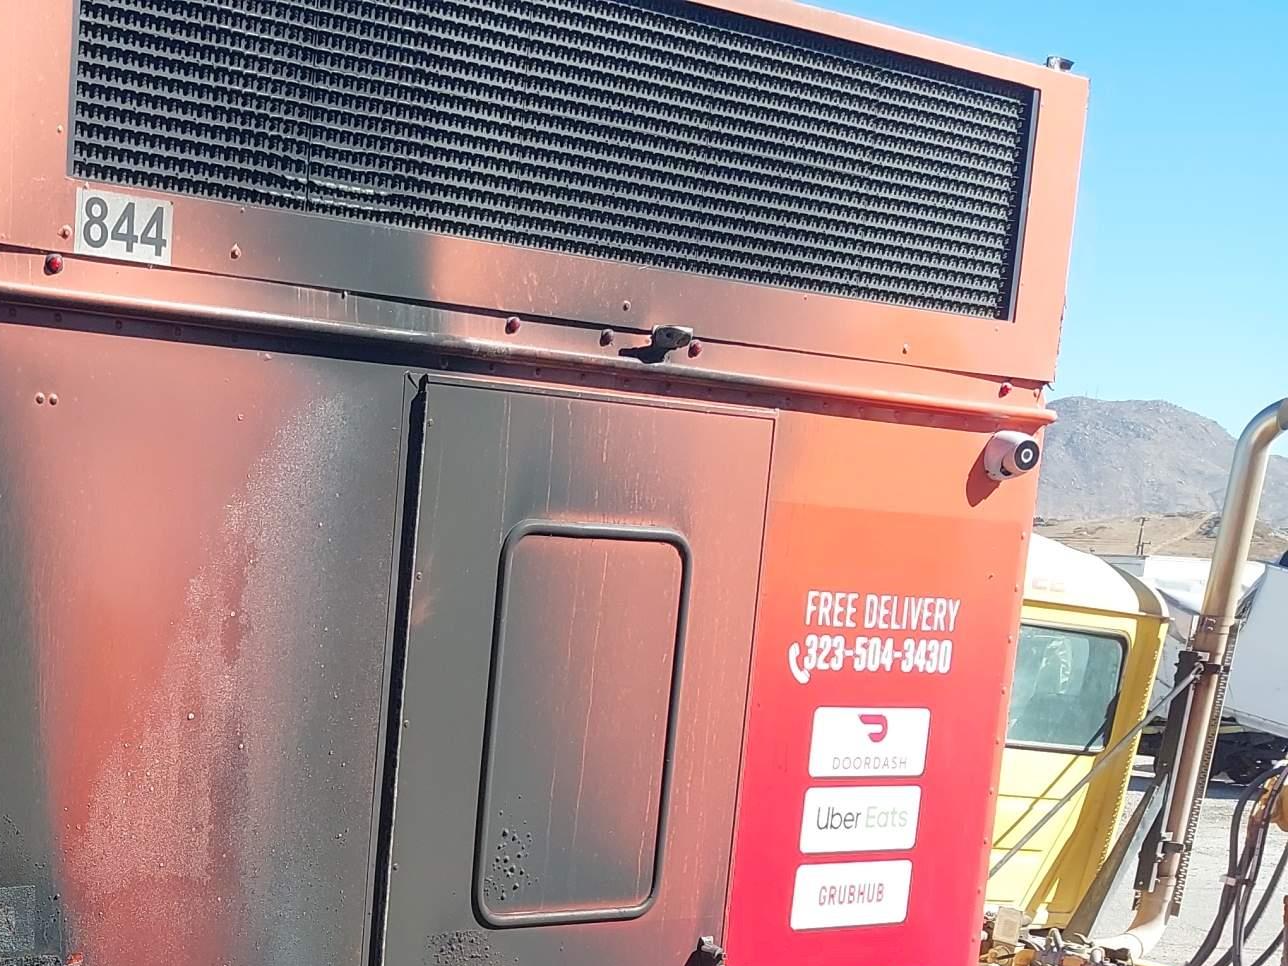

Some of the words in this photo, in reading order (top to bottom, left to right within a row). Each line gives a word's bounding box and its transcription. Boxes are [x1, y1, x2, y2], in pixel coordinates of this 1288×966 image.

[83, 196, 167, 257] 844
[804, 590, 859, 628] FREE
[864, 594, 961, 632] DELIVERY
[803, 634, 953, 674] 323-504-3430
[832, 756, 907, 770] DOORDASH
[816, 806, 862, 831] Uber
[865, 806, 909, 829] Eats
[818, 883, 885, 907] GRUBHUB
